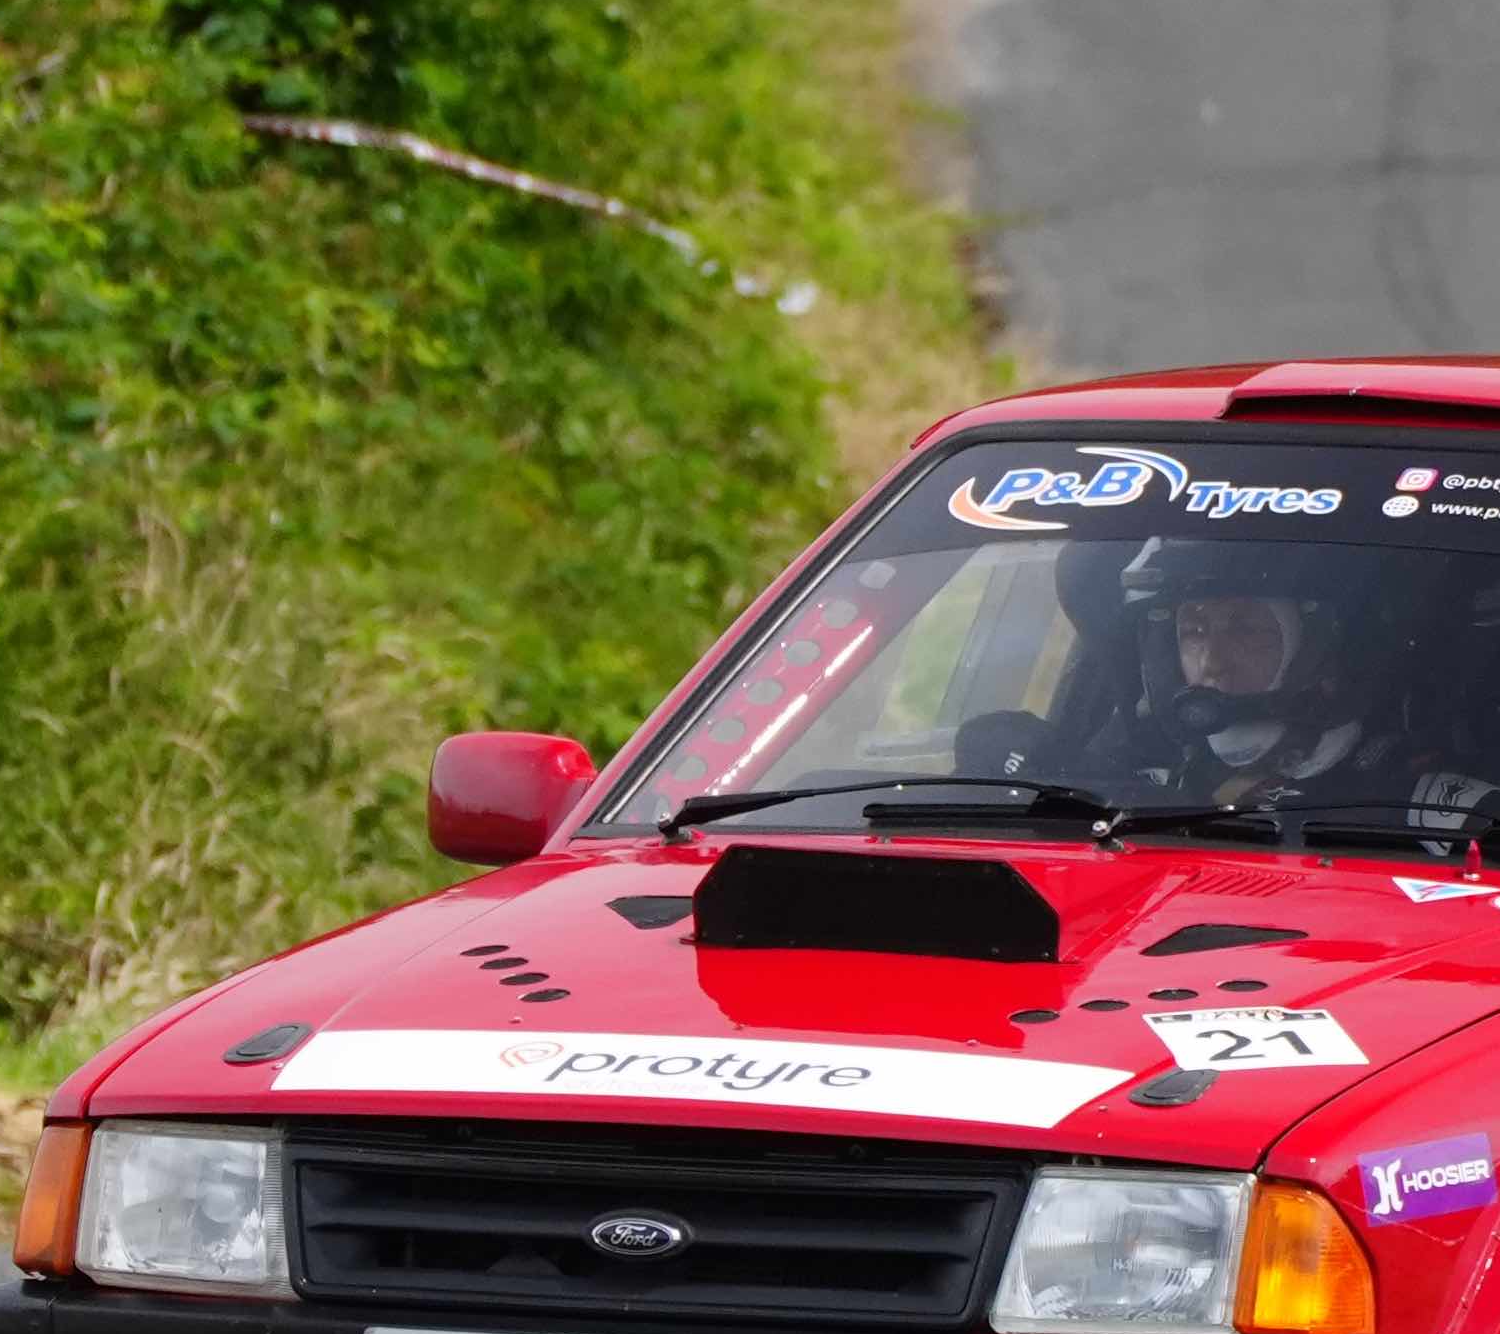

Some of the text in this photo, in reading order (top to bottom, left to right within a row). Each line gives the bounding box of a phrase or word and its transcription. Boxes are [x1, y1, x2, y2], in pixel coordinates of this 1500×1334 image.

[981, 461, 1342, 518] P&B Tyres
[1195, 1029, 1314, 1061] 21
[544, 1051, 872, 1091] protyre
[1401, 1158, 1491, 1194] HOOSIER
[610, 1224, 658, 1246] Ford
